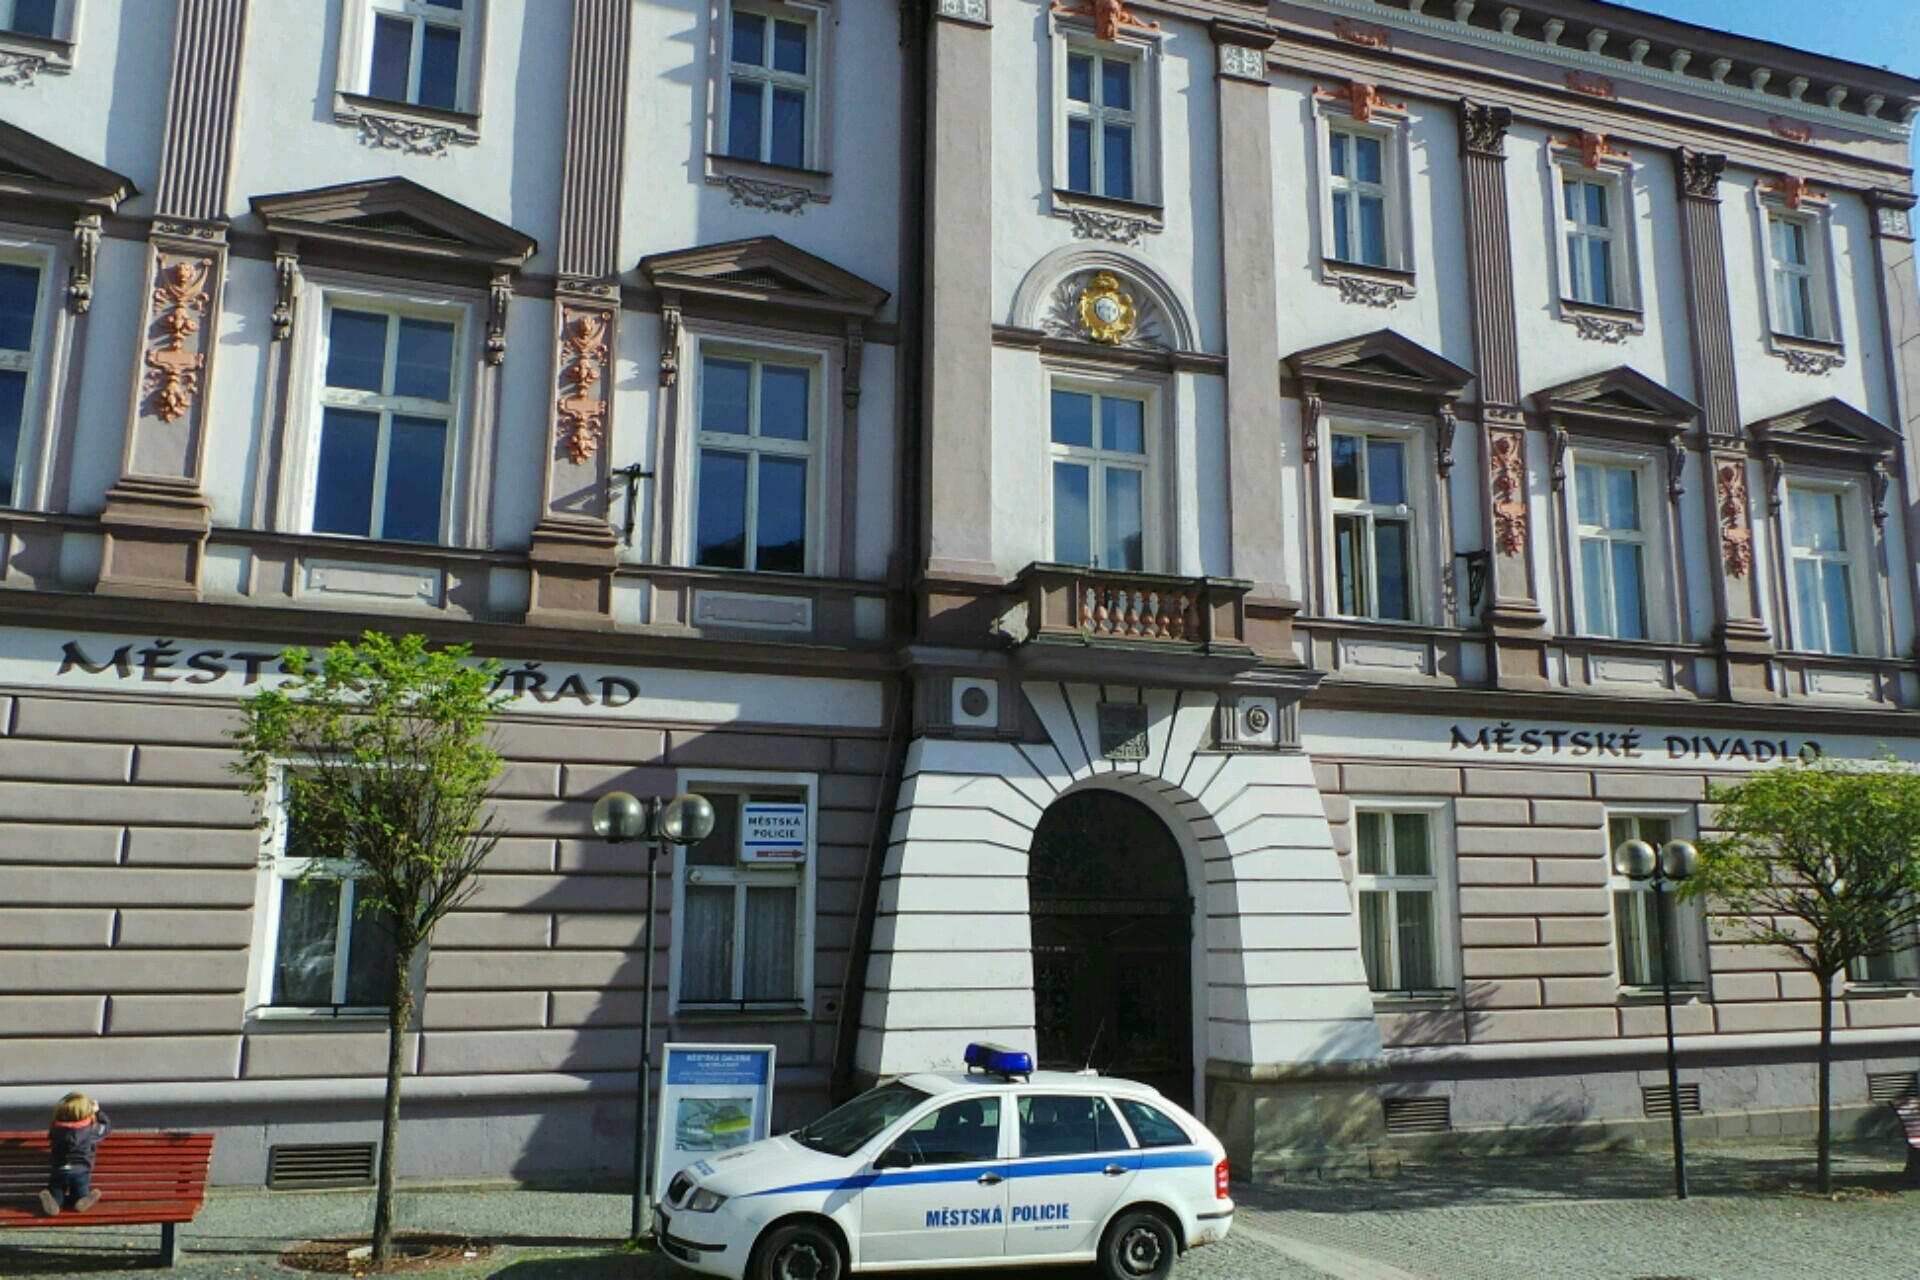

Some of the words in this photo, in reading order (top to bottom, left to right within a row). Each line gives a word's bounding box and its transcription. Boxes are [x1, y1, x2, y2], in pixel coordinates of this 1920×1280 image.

[1450, 721, 1643, 759] MĚSTSKÉ
[1663, 734, 1822, 766] DIVADLO
[747, 816, 801, 826] MĚSTSKÁ
[753, 829, 797, 838] POLICIE
[926, 1204, 1002, 1227] MĚSTSKÁ
[1012, 1203, 1069, 1221] POLICIE
